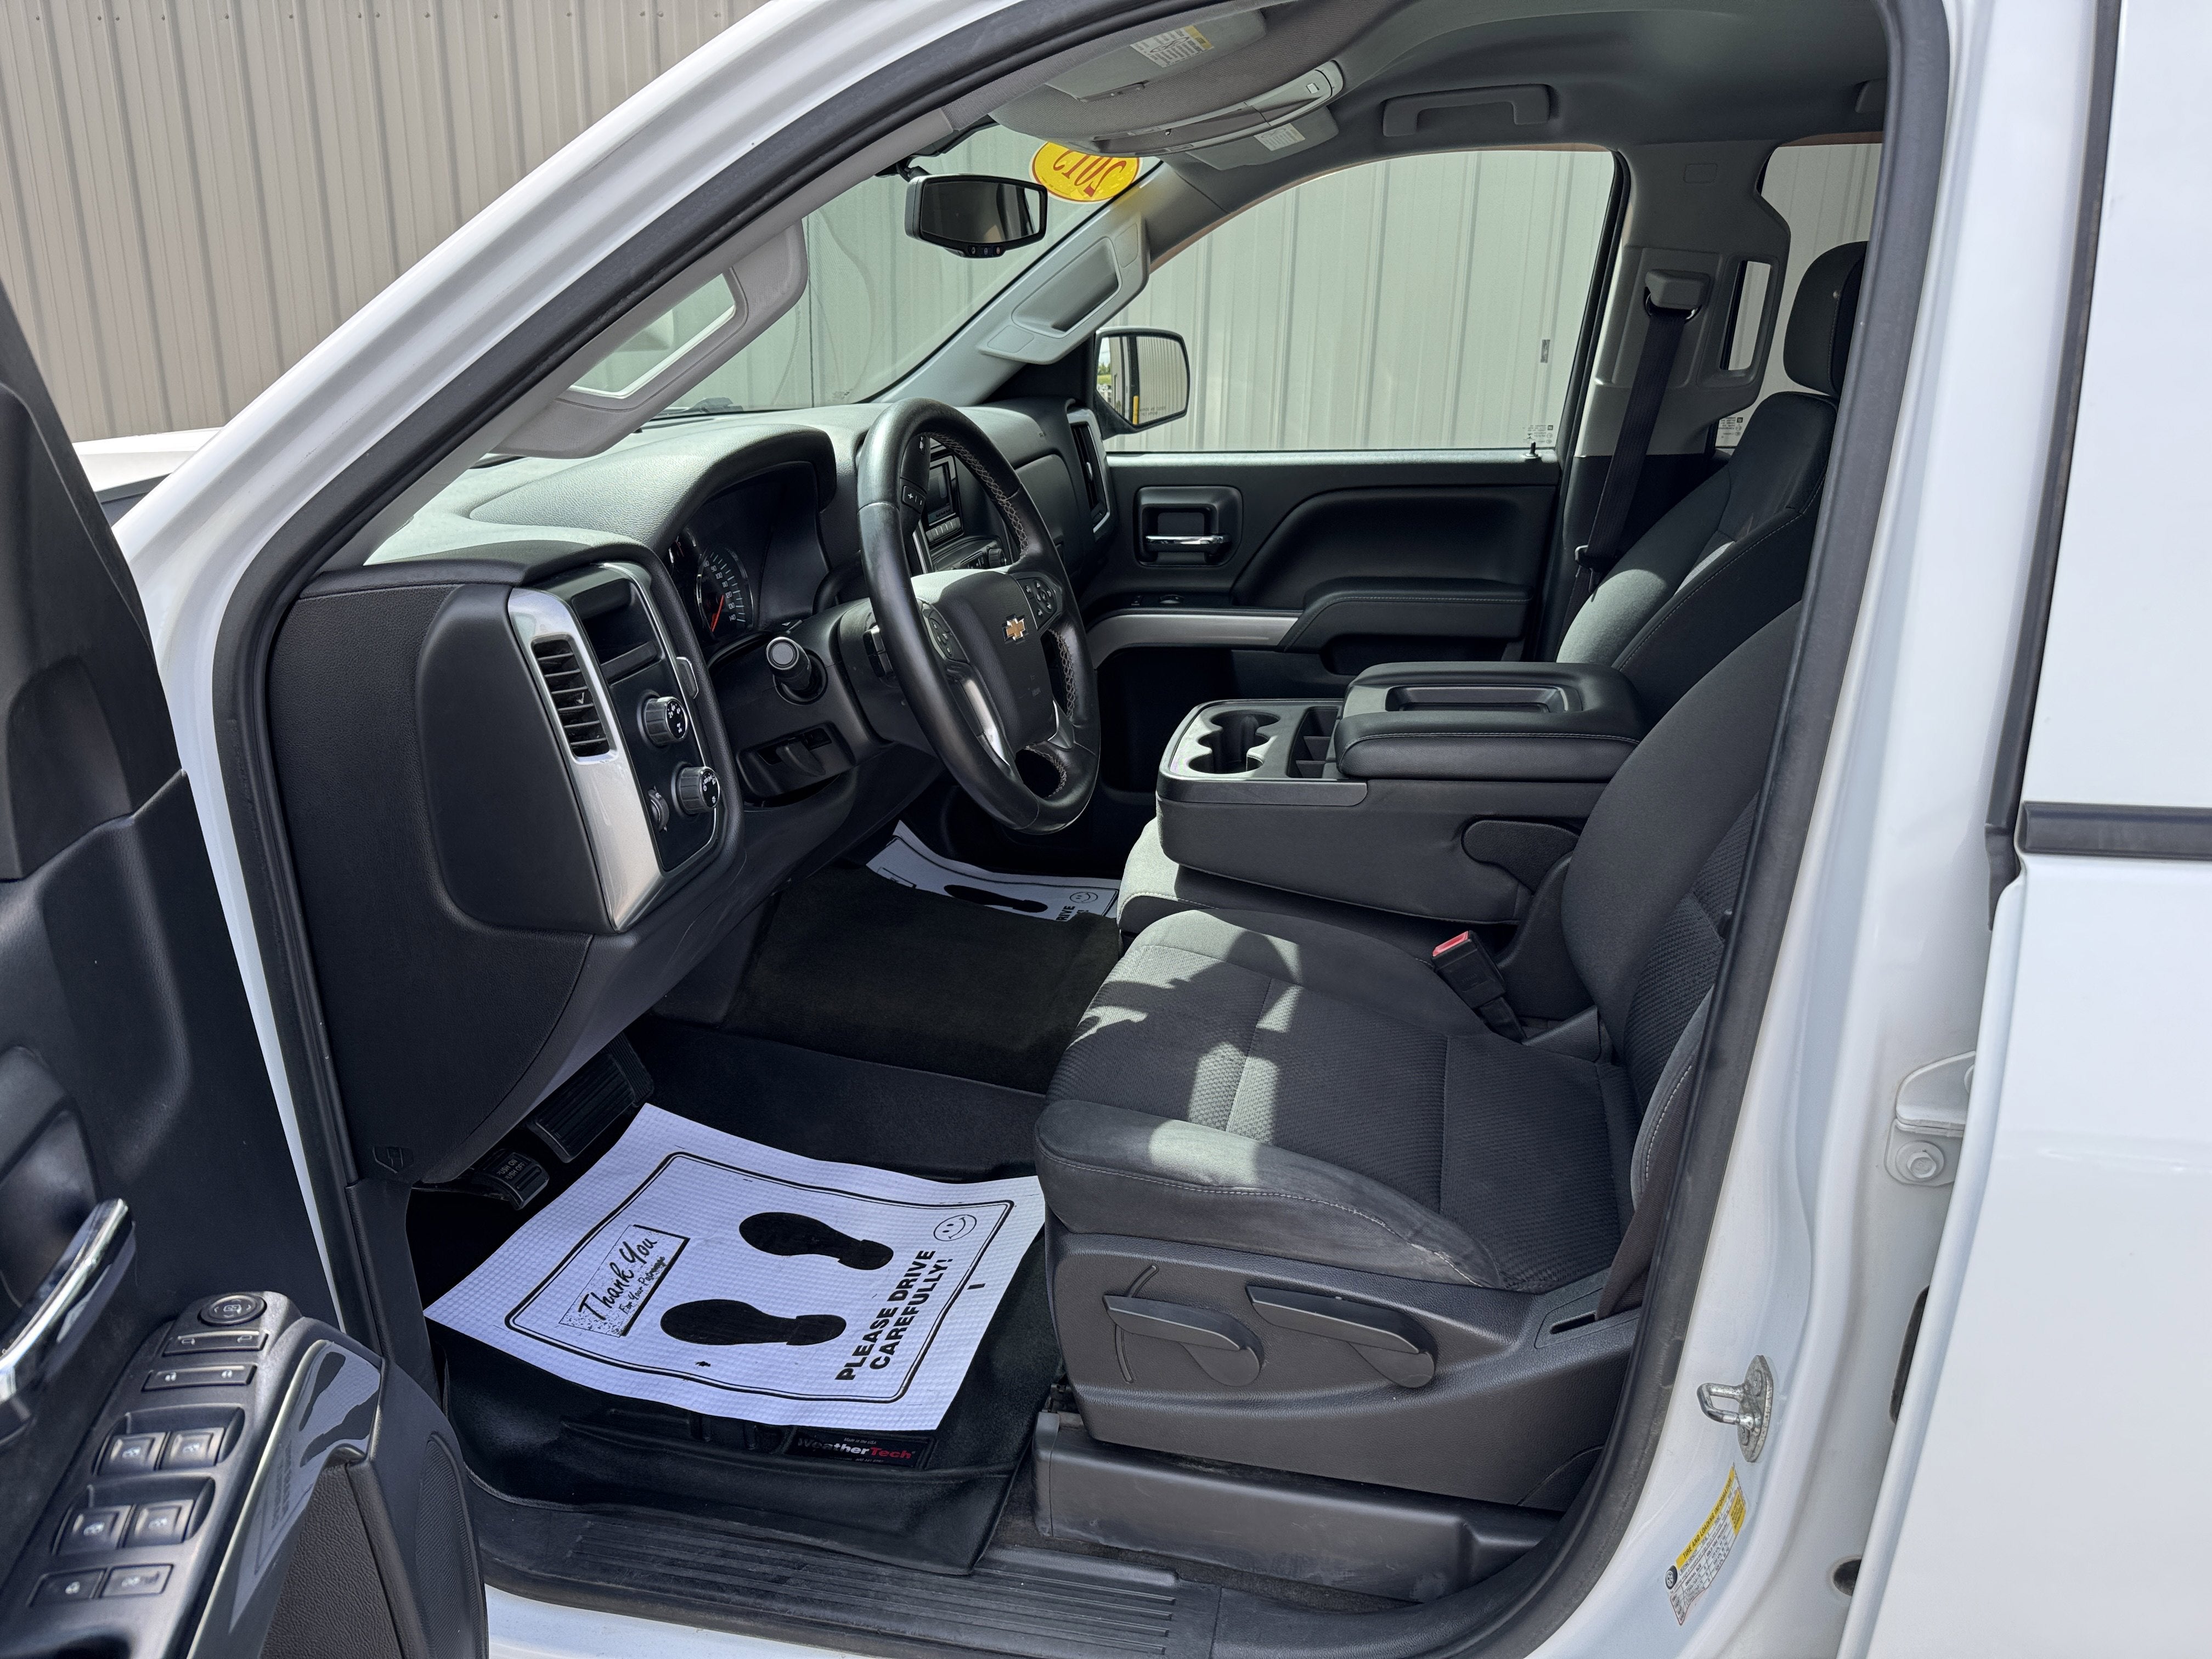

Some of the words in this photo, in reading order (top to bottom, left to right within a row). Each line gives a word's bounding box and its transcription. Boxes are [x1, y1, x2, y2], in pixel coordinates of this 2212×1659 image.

[1056, 905, 1075, 921] RIVE
[515, 1162, 526, 1171] OFF
[578, 1262, 635, 1321] Thank
[619, 1238, 658, 1264] You
[618, 1301, 633, 1314] For
[834, 1306, 899, 1380] PLEASE
[887, 1250, 936, 1302] DRIVE
[870, 1259, 953, 1370] CAREFULLY!
[1692, 1534, 1700, 1549] AND
[1700, 1513, 1715, 1537] LOADING
